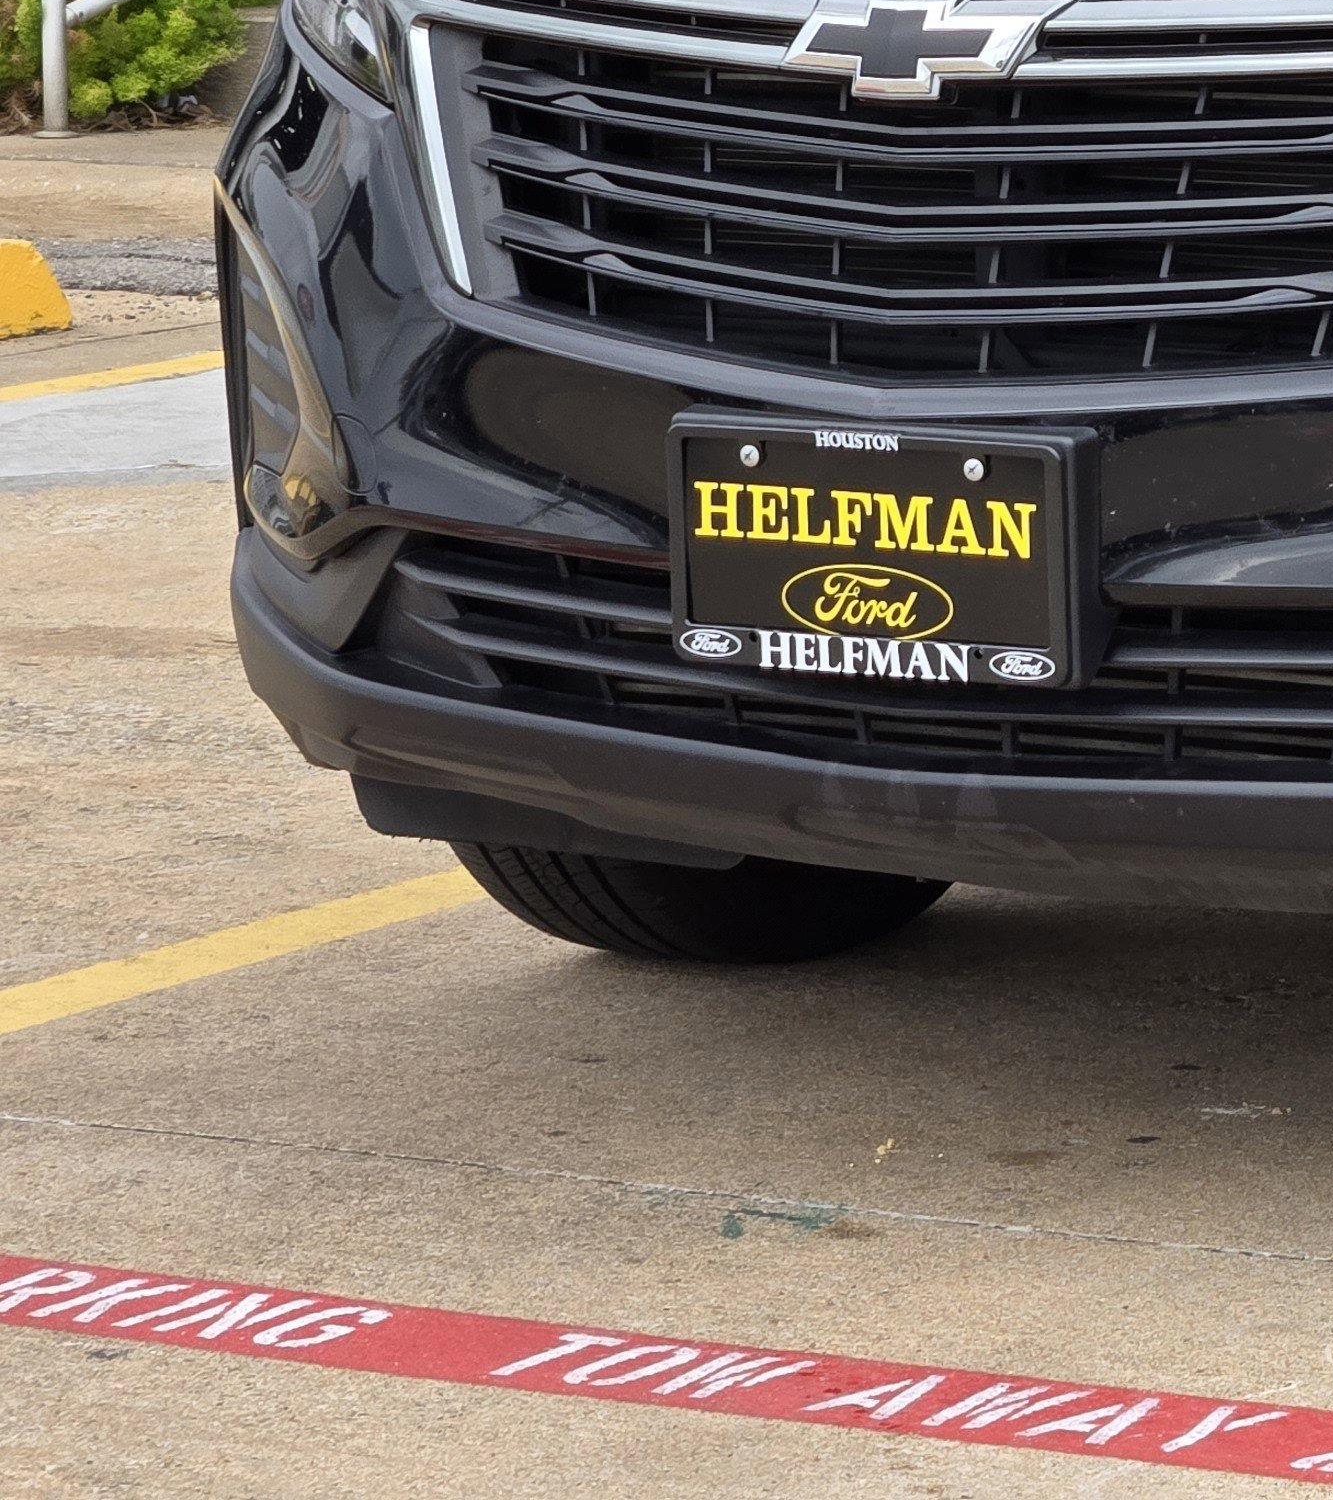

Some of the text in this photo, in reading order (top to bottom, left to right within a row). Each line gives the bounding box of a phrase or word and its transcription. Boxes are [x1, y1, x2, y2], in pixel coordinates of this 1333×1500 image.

[814, 430, 900, 453] HOUSTON
[693, 479, 1038, 560] HELFMAN
[813, 571, 919, 630] Ford
[690, 632, 730, 655] Ford
[758, 630, 974, 683] HELFMAN
[1001, 654, 1043, 677] Ford
[488, 1333, 818, 1399] TOW
[800, 1374, 1290, 1453] AWAY
